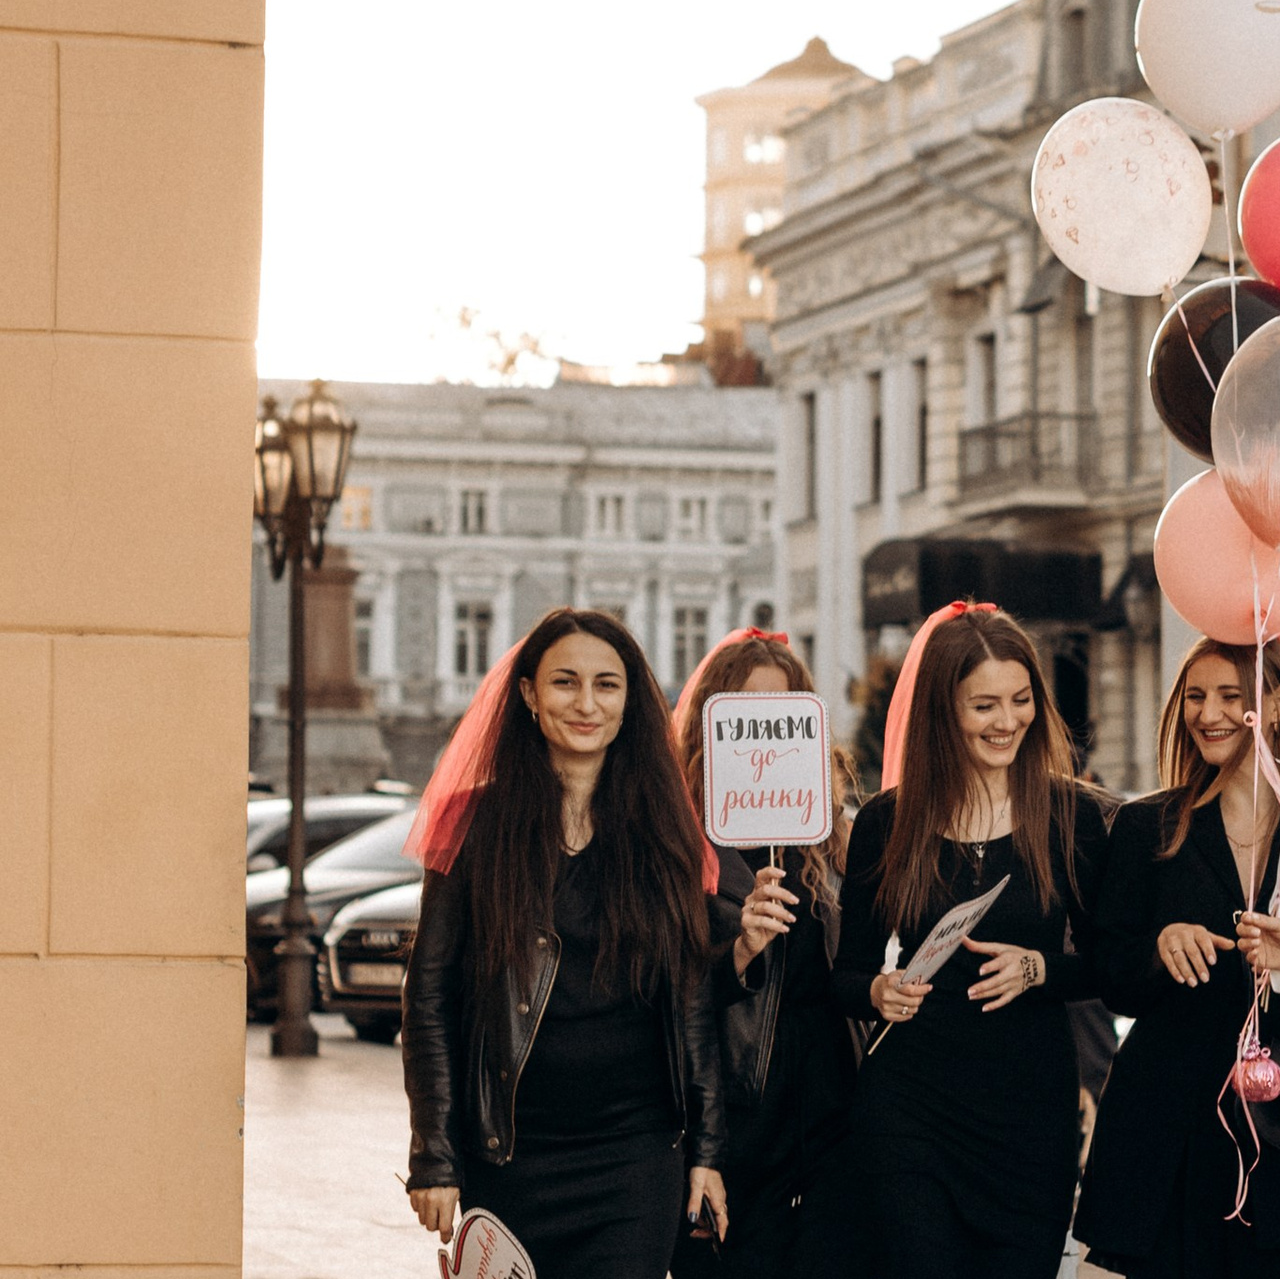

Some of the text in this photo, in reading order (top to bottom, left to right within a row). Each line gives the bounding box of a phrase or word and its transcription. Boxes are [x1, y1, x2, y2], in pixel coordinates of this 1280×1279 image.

[716, 715, 818, 741] ГУЛЯЄМО
[734, 748, 800, 783] до
[719, 788, 818, 828] ранку
